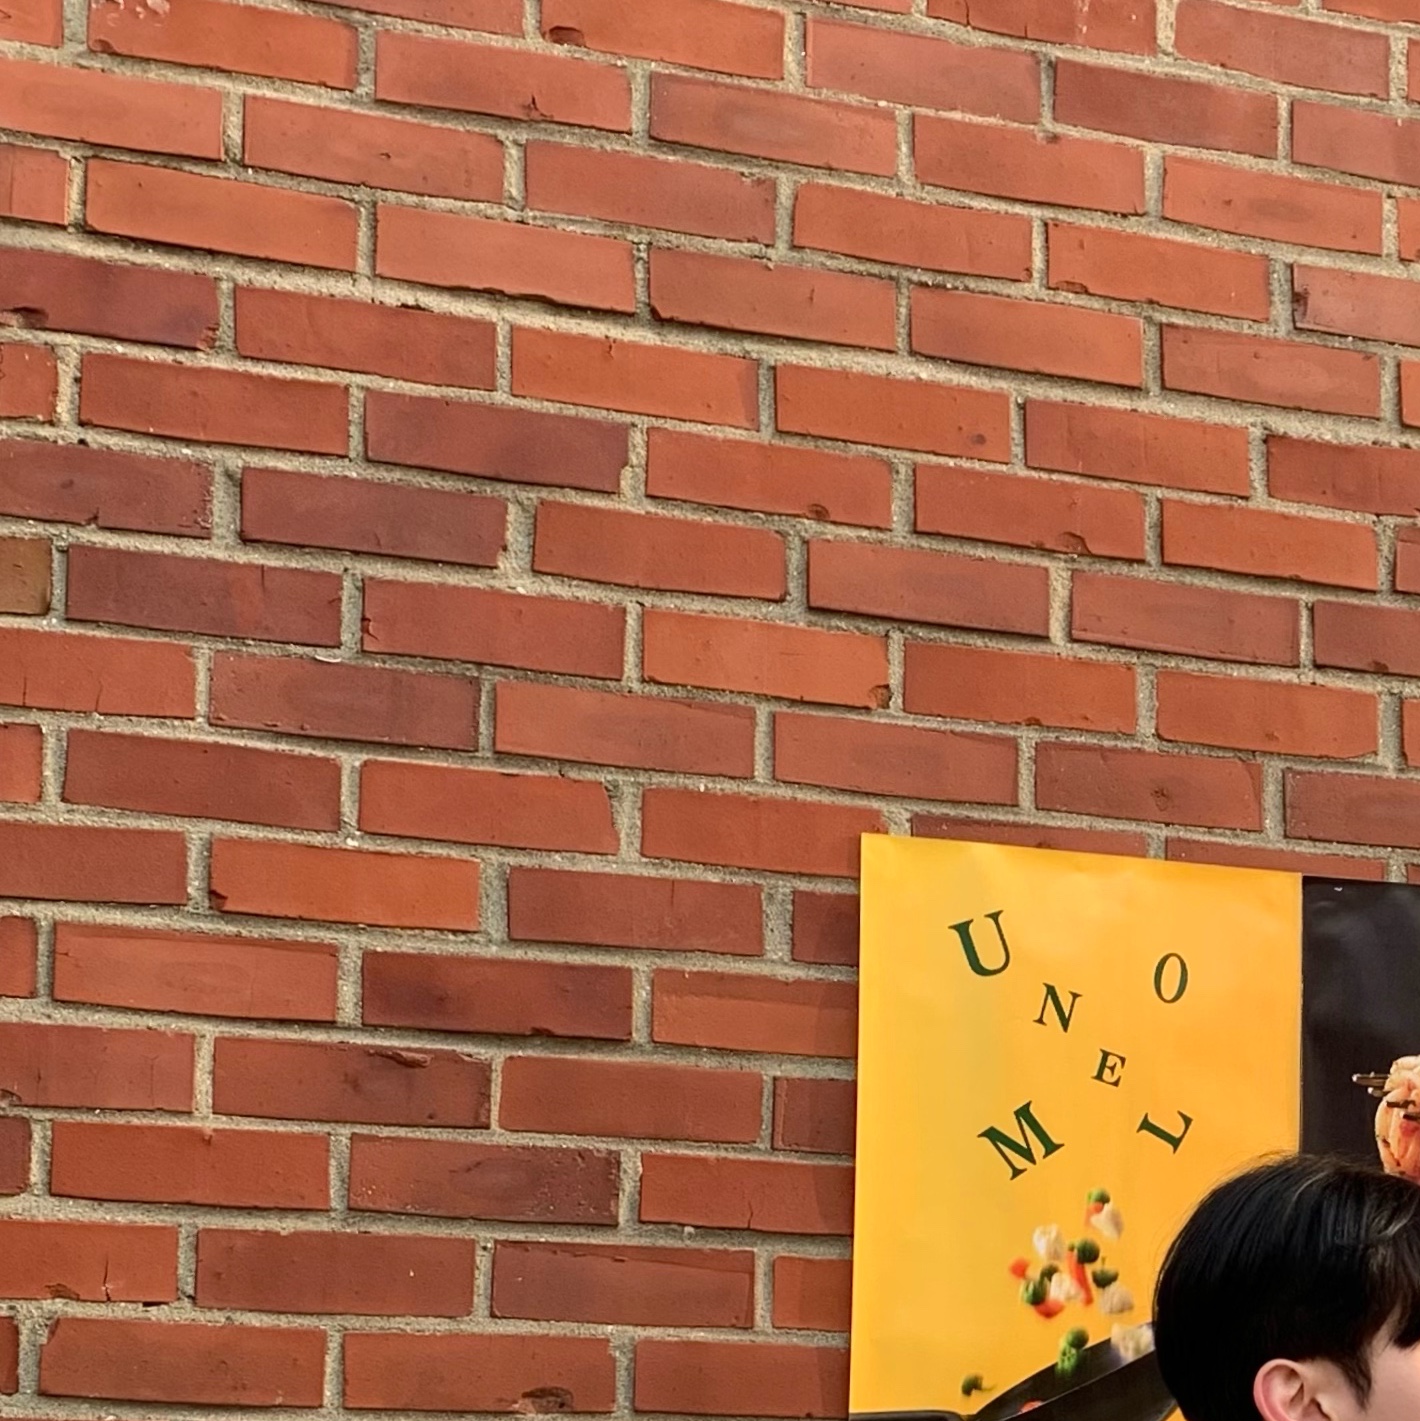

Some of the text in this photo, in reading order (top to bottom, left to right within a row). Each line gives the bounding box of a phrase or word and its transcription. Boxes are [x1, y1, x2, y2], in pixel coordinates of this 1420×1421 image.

[948, 910, 1011, 977] U
[1033, 982, 1083, 1033] N
[1091, 1048, 1127, 1087] E
[977, 1100, 1065, 1181] M
[1136, 1110, 1194, 1154] L
